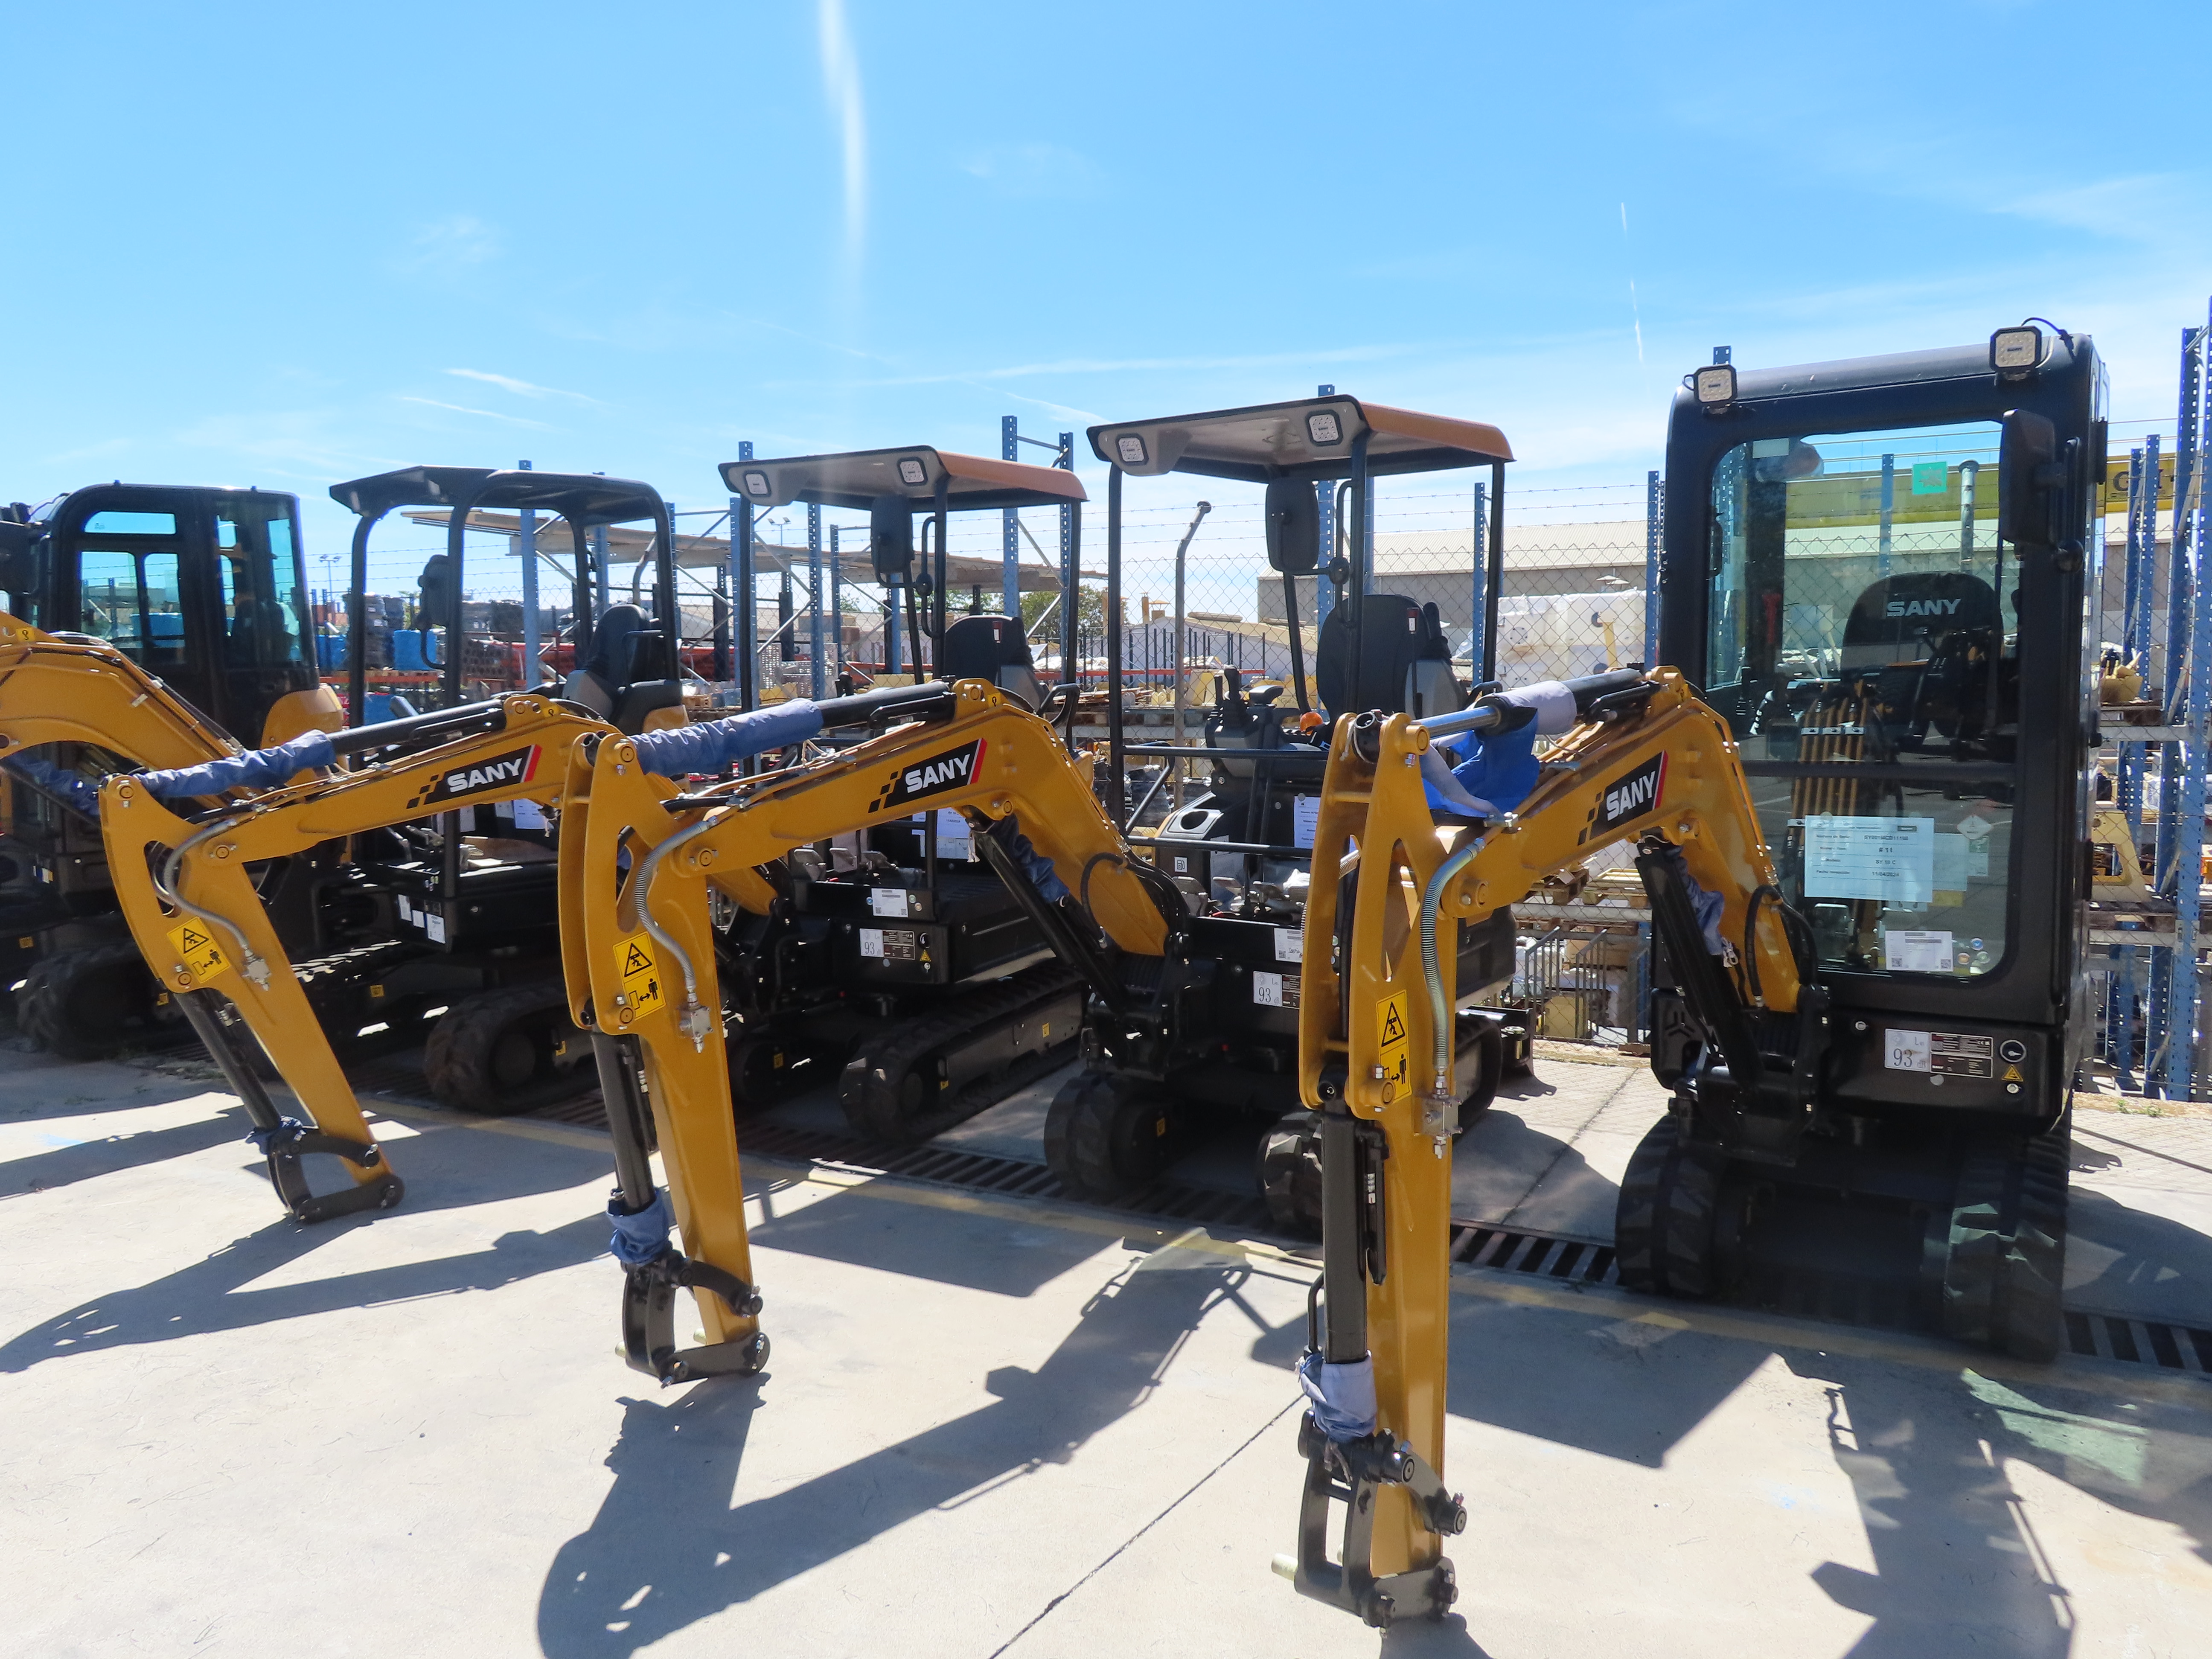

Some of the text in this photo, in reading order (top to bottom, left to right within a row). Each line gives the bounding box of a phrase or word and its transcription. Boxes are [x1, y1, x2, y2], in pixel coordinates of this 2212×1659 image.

[1887, 598, 1962, 617] SANY
[448, 757, 522, 793] SANY
[905, 754, 971, 793] SANY
[1606, 771, 1656, 821] SANY
[864, 941, 875, 955] 93
[1259, 987, 1271, 1003] 93
[1893, 1048, 1913, 1067] 93
